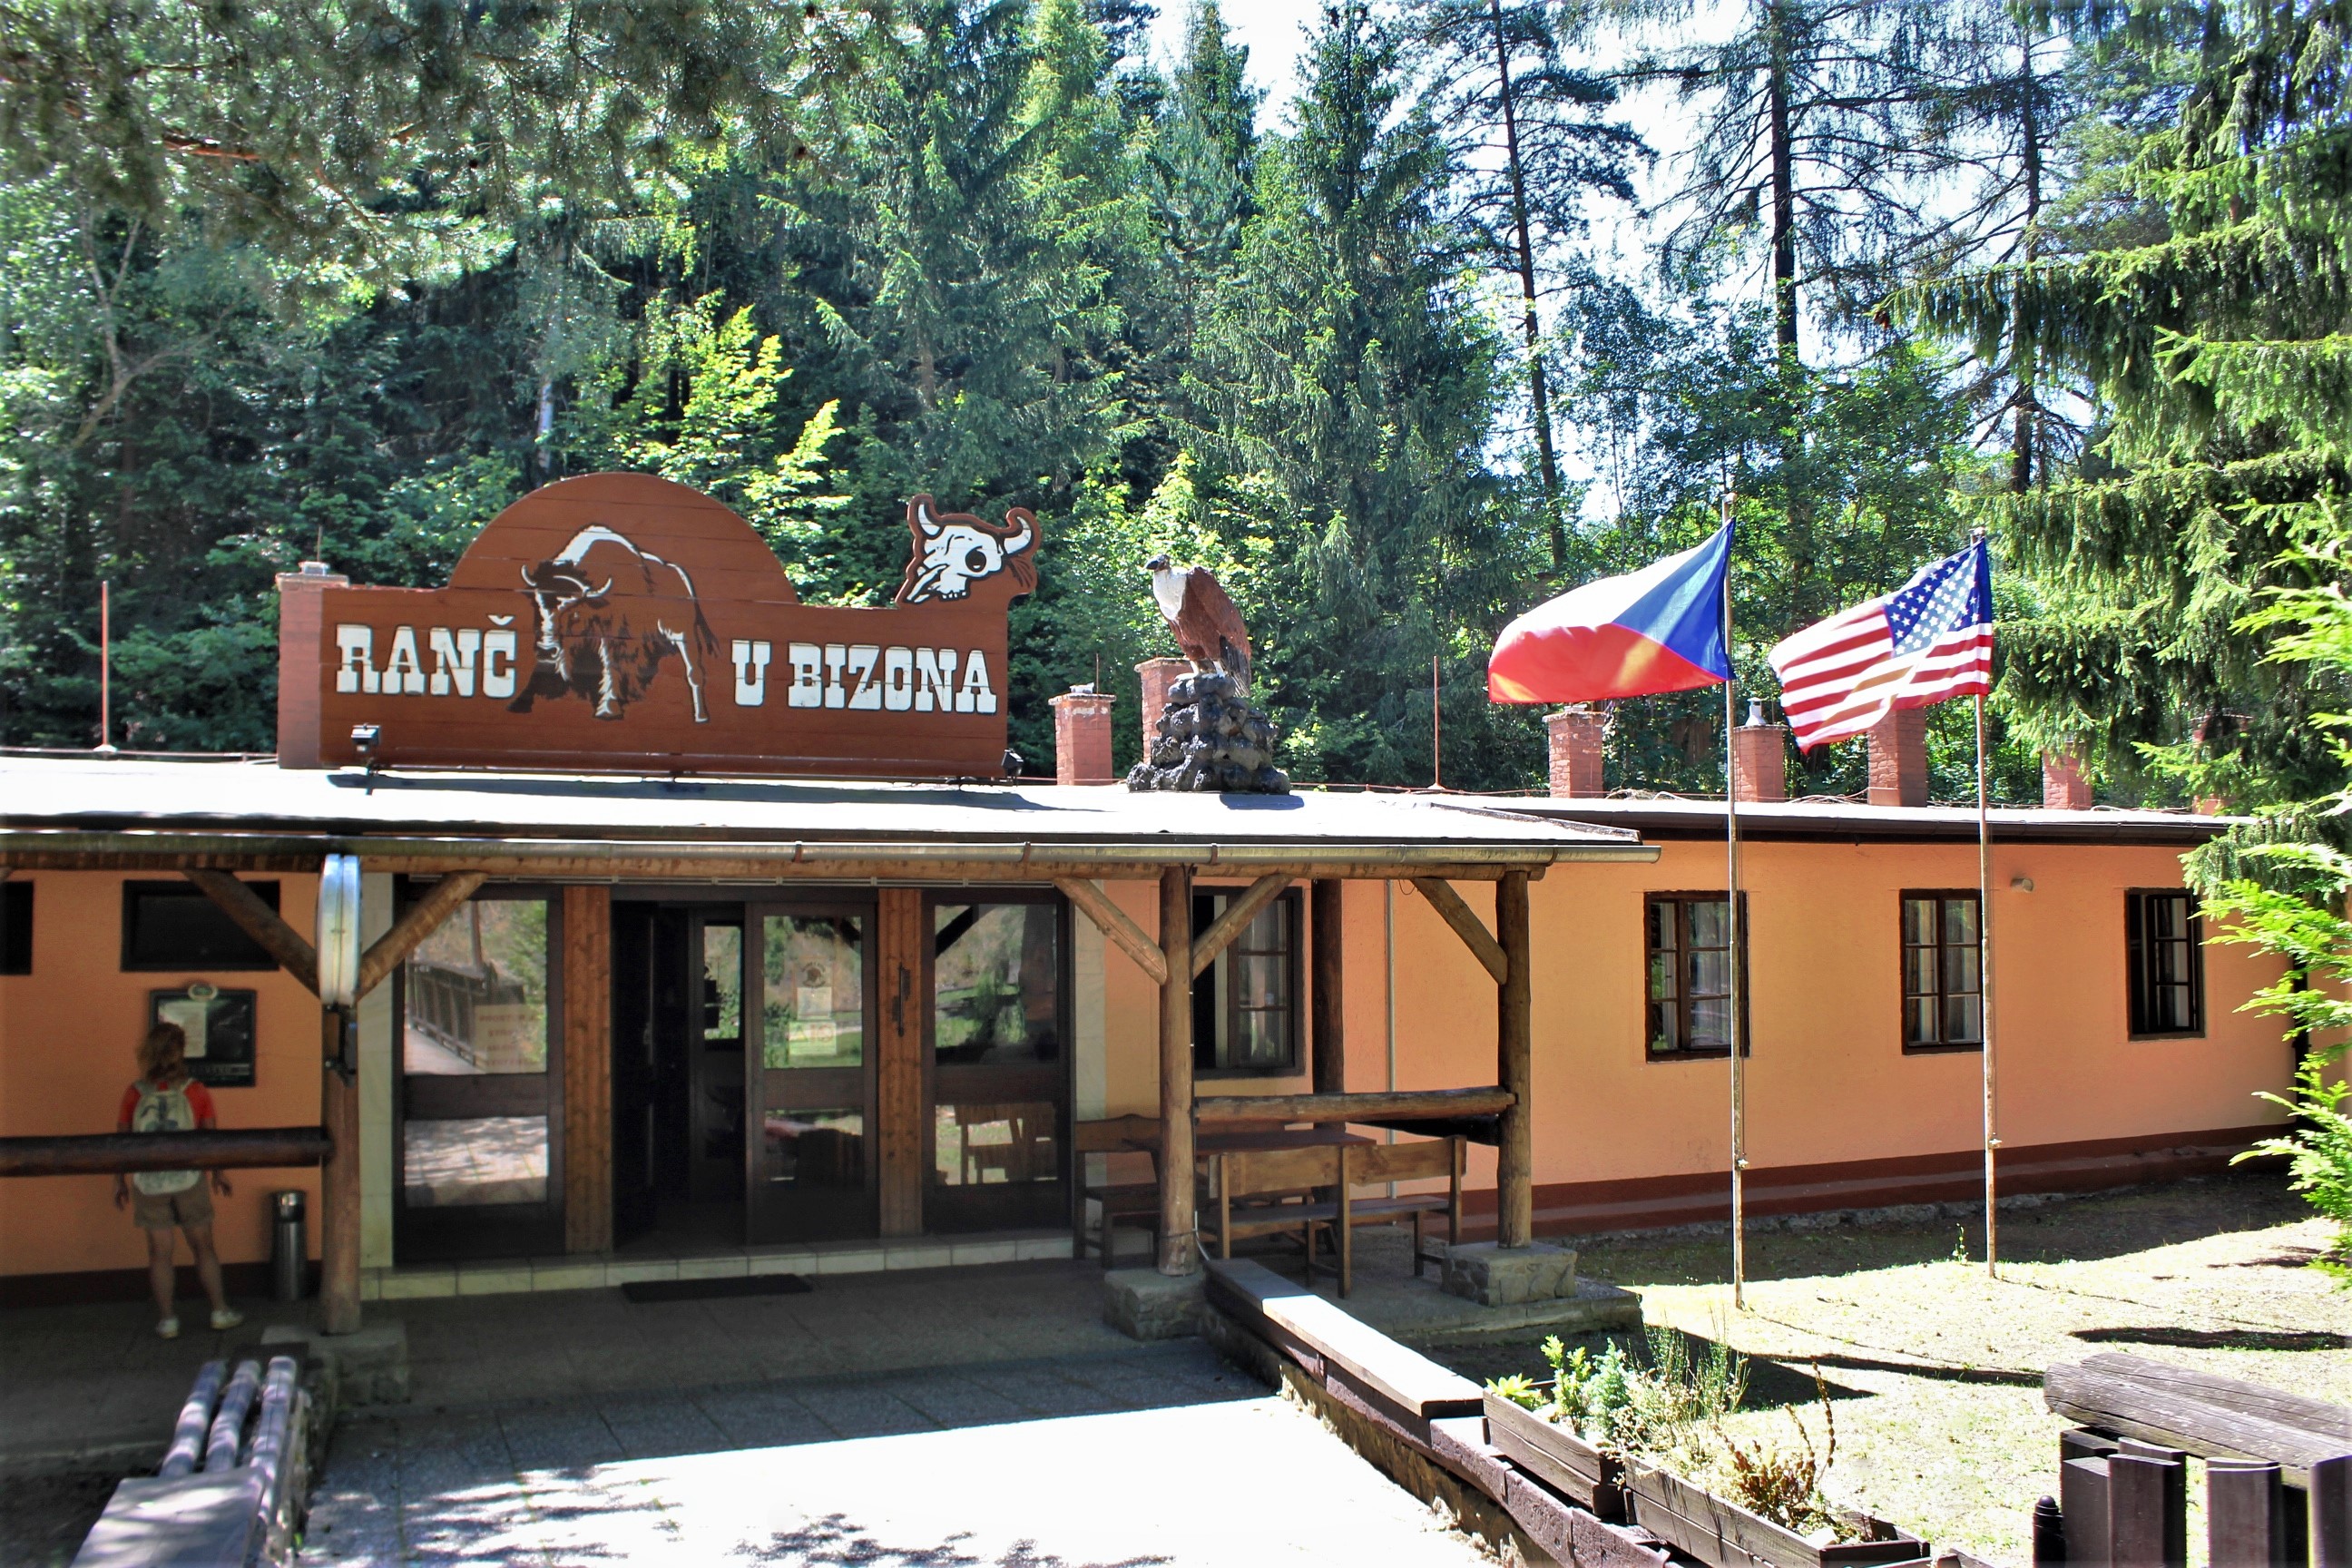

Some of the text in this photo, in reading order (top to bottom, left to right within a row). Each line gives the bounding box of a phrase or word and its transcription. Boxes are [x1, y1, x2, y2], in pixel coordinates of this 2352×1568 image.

[336, 614, 997, 714] RANČ U BIZONA
